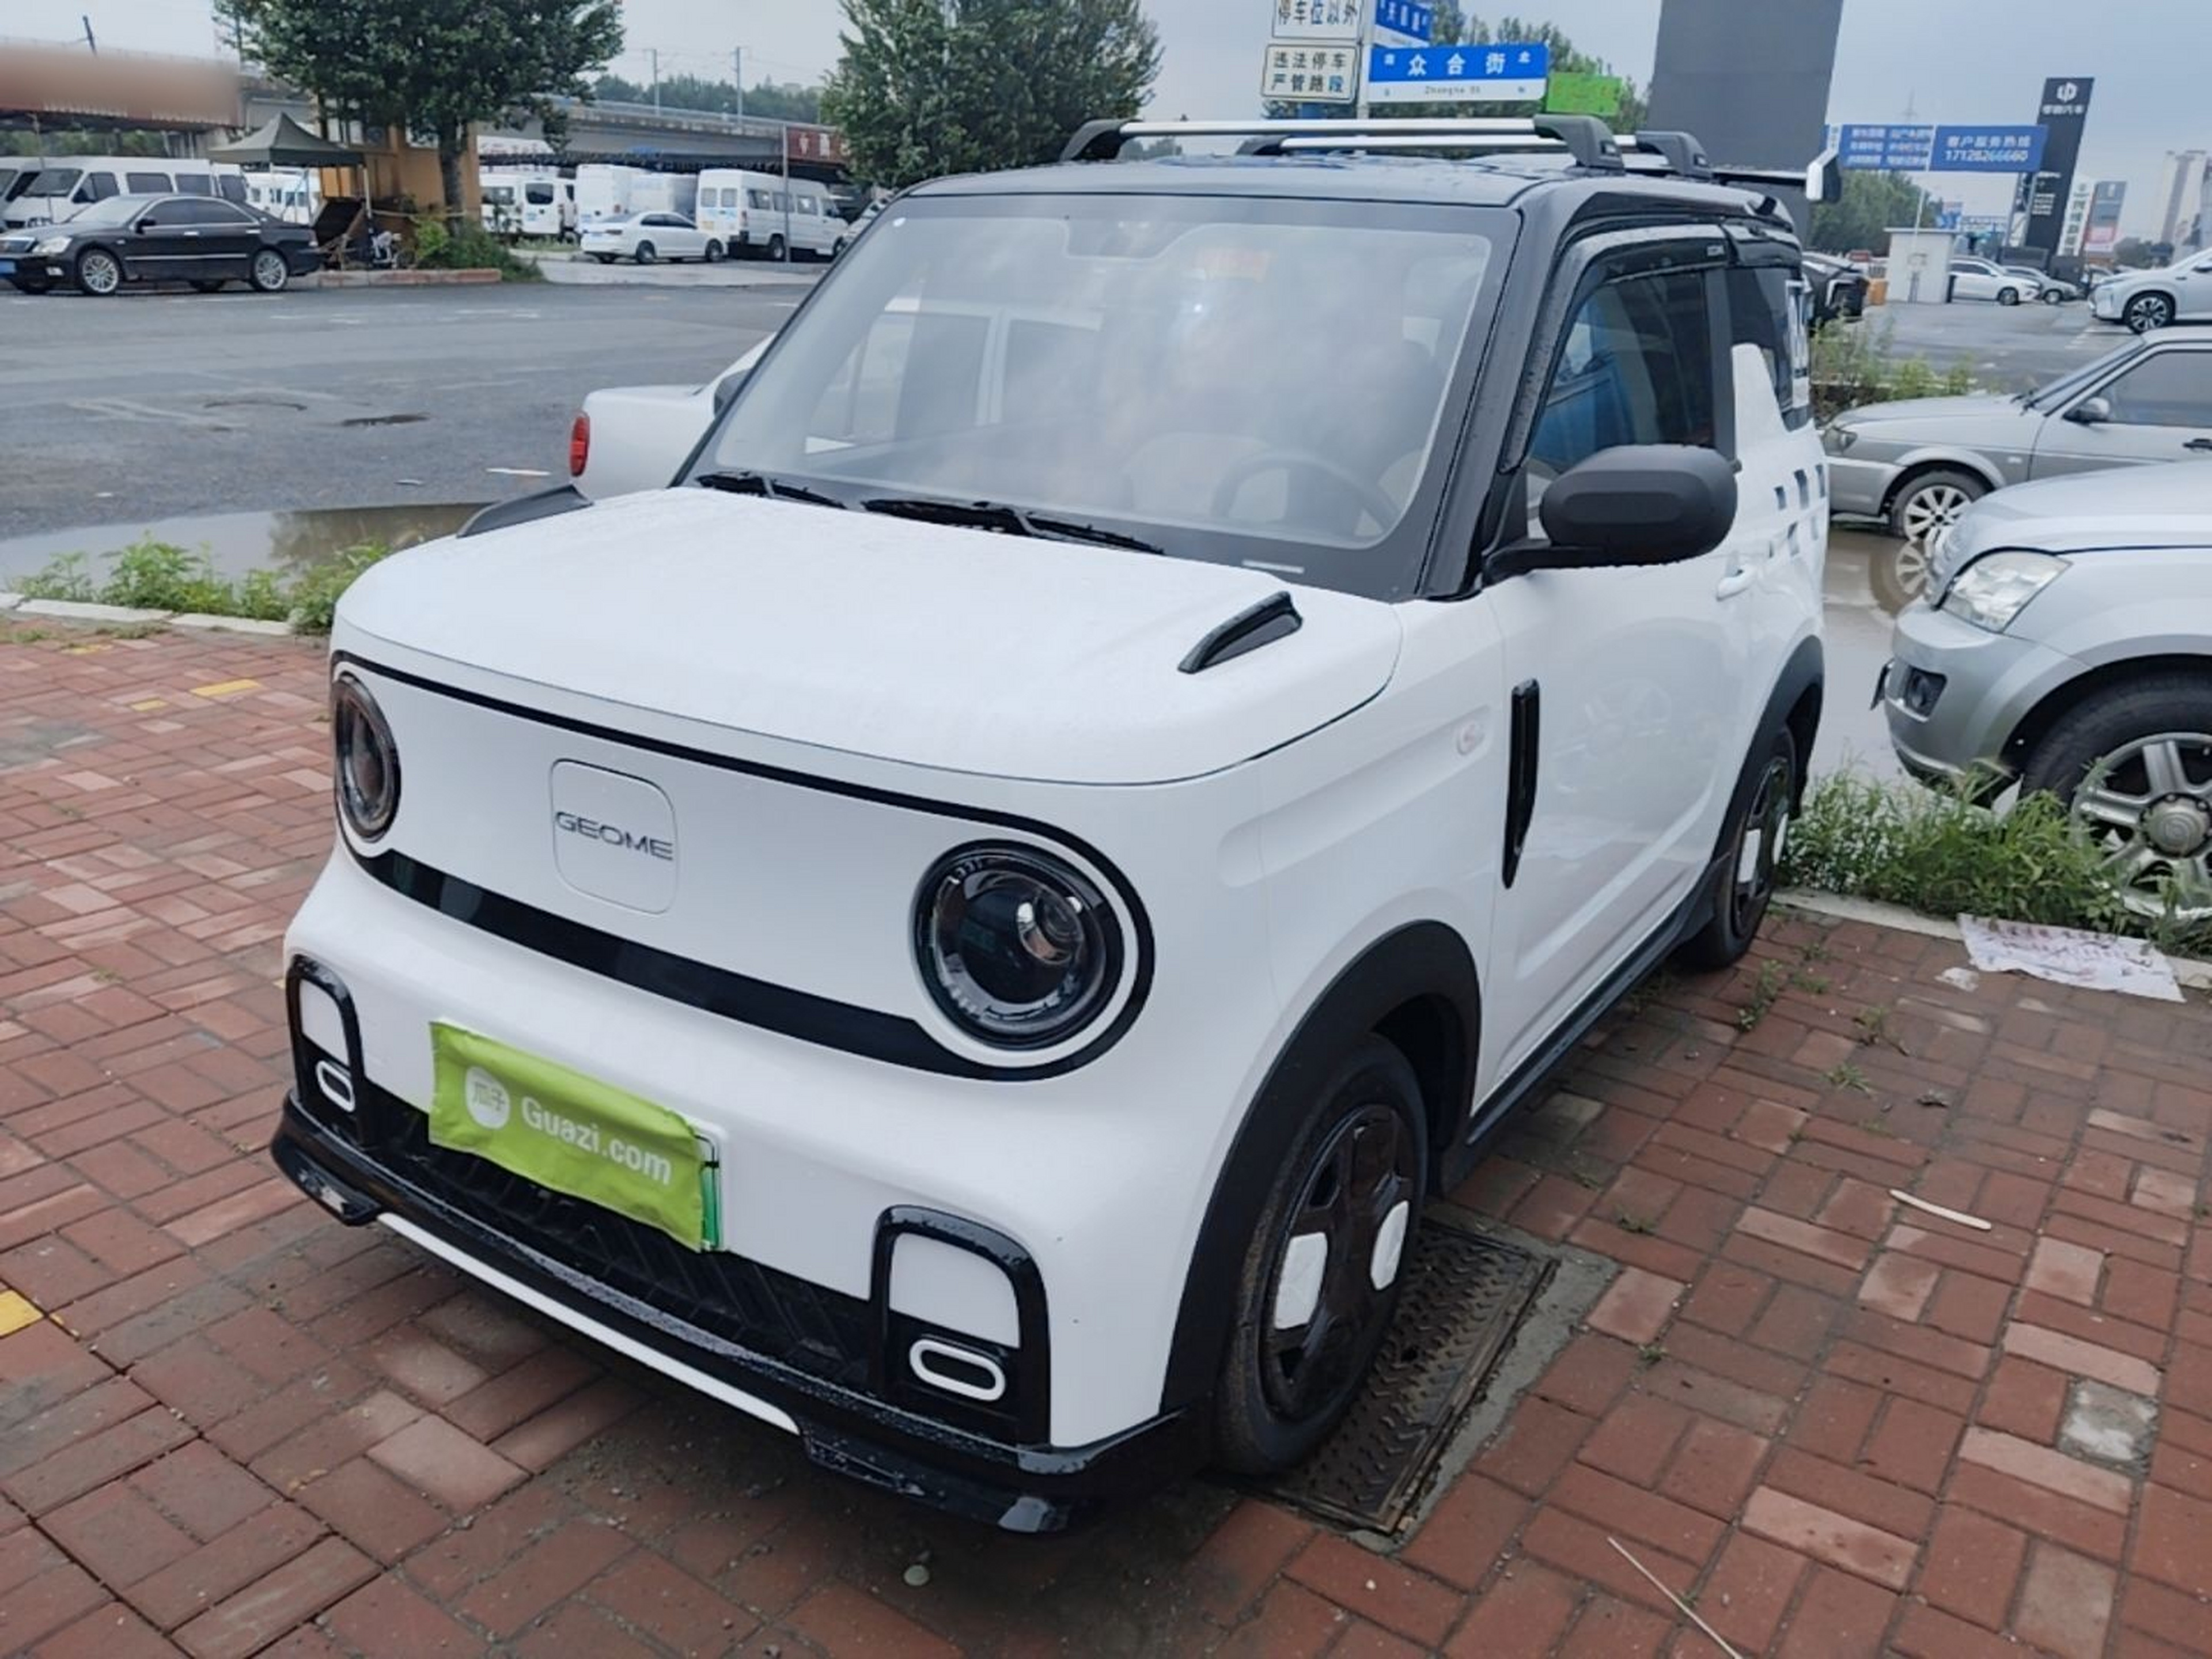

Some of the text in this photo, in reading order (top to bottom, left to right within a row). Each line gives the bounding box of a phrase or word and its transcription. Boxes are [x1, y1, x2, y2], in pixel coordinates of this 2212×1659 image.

[1274, 52, 1346, 70] 违法停车
[1407, 52, 1506, 76] 众合街
[1271, 73, 1344, 93] 严管路段
[555, 812, 673, 861] GEOME
[521, 1096, 671, 1185] Guazi.com
